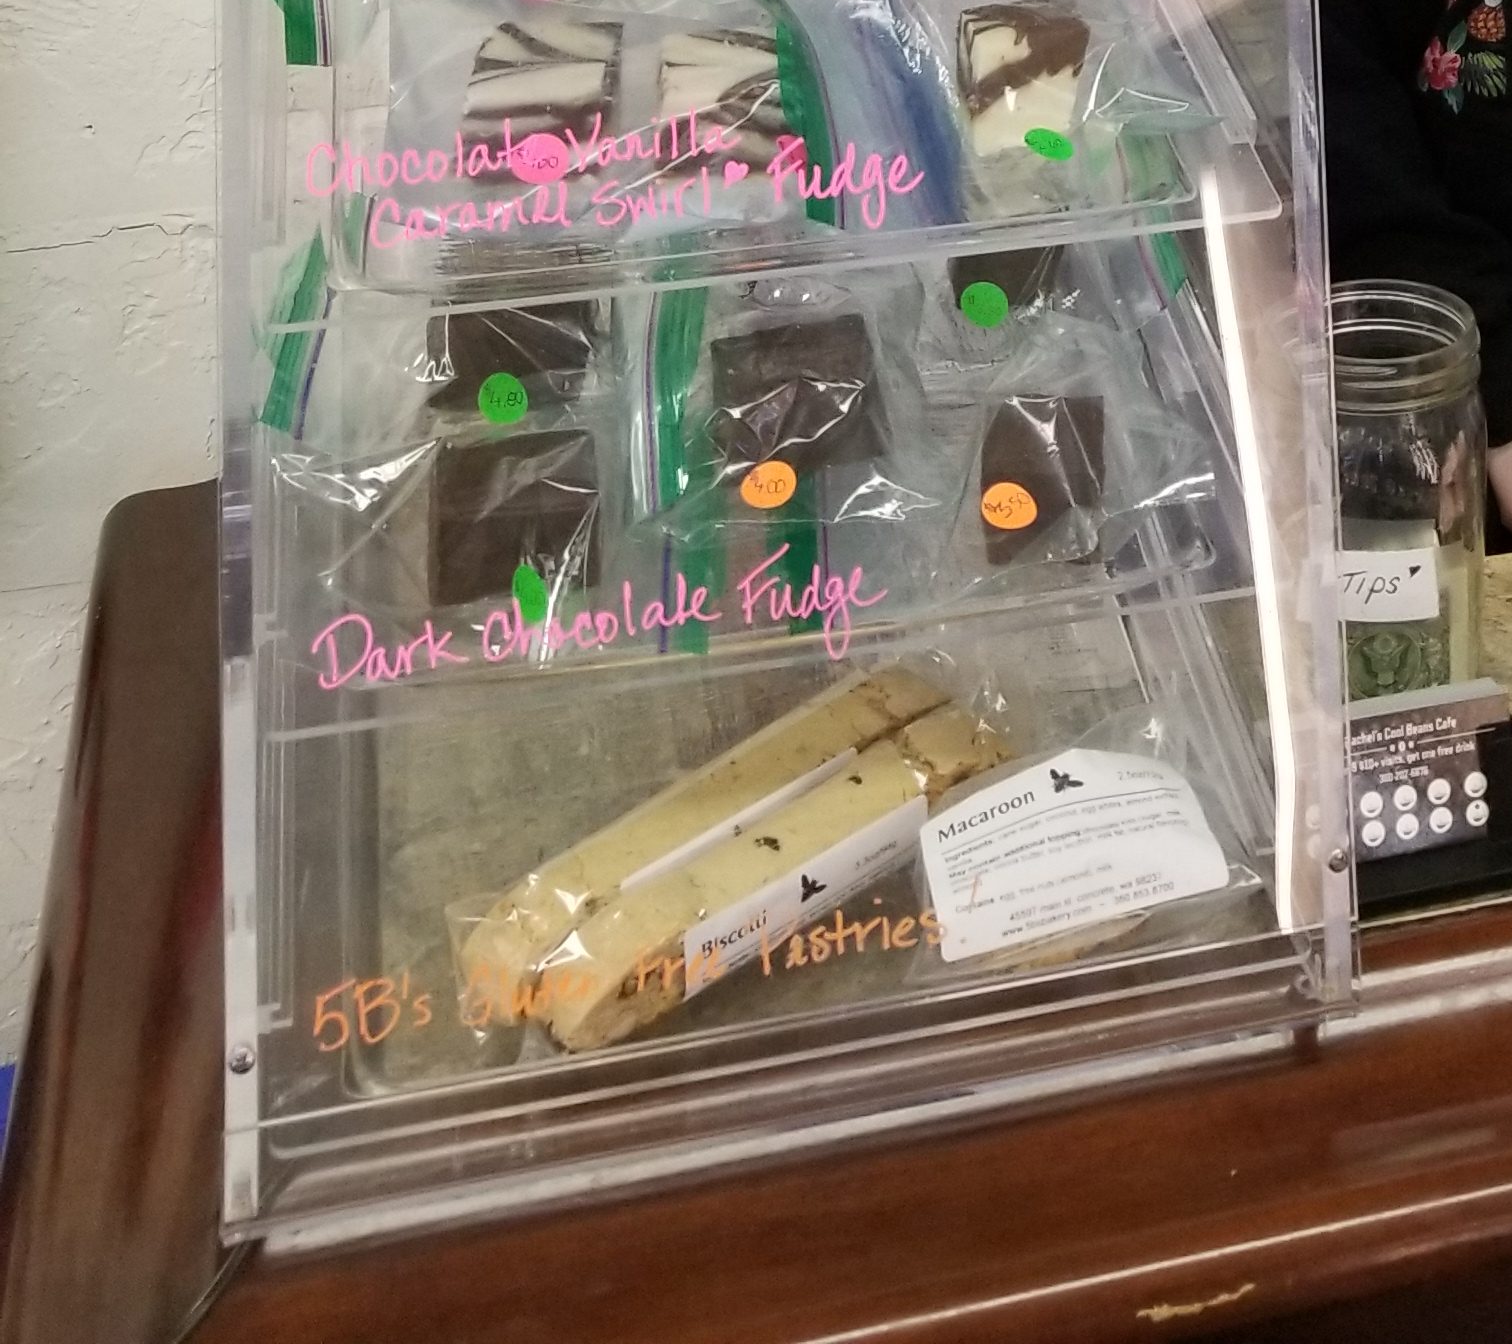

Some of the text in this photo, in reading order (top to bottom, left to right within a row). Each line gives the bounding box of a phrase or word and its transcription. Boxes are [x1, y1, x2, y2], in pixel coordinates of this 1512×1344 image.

[591, 167, 713, 227] Swirl
[768, 134, 925, 229] Fudge
[311, 543, 888, 690] Dark Chocolate Fudge
[1339, 569, 1401, 605] Tips
[937, 789, 1036, 844] Macaroon
